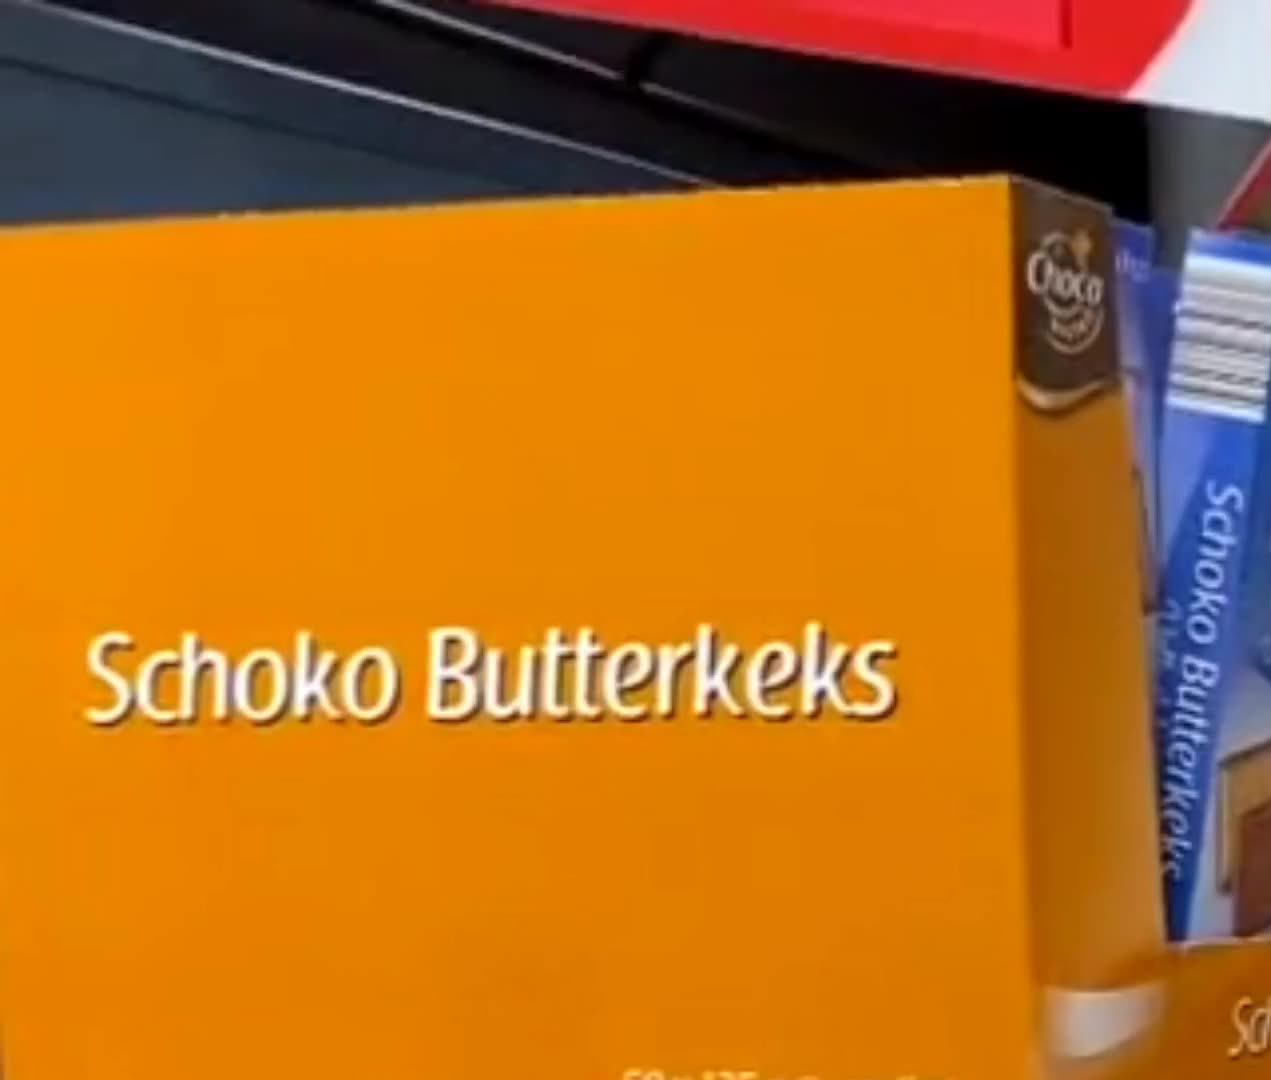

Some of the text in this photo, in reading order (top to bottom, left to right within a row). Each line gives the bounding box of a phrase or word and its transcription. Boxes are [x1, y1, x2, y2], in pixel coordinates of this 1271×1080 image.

[1027, 250, 1105, 307] Choco
[1185, 479, 1246, 646] Schoko
[84, 622, 899, 729] Schoko Butterkeks
